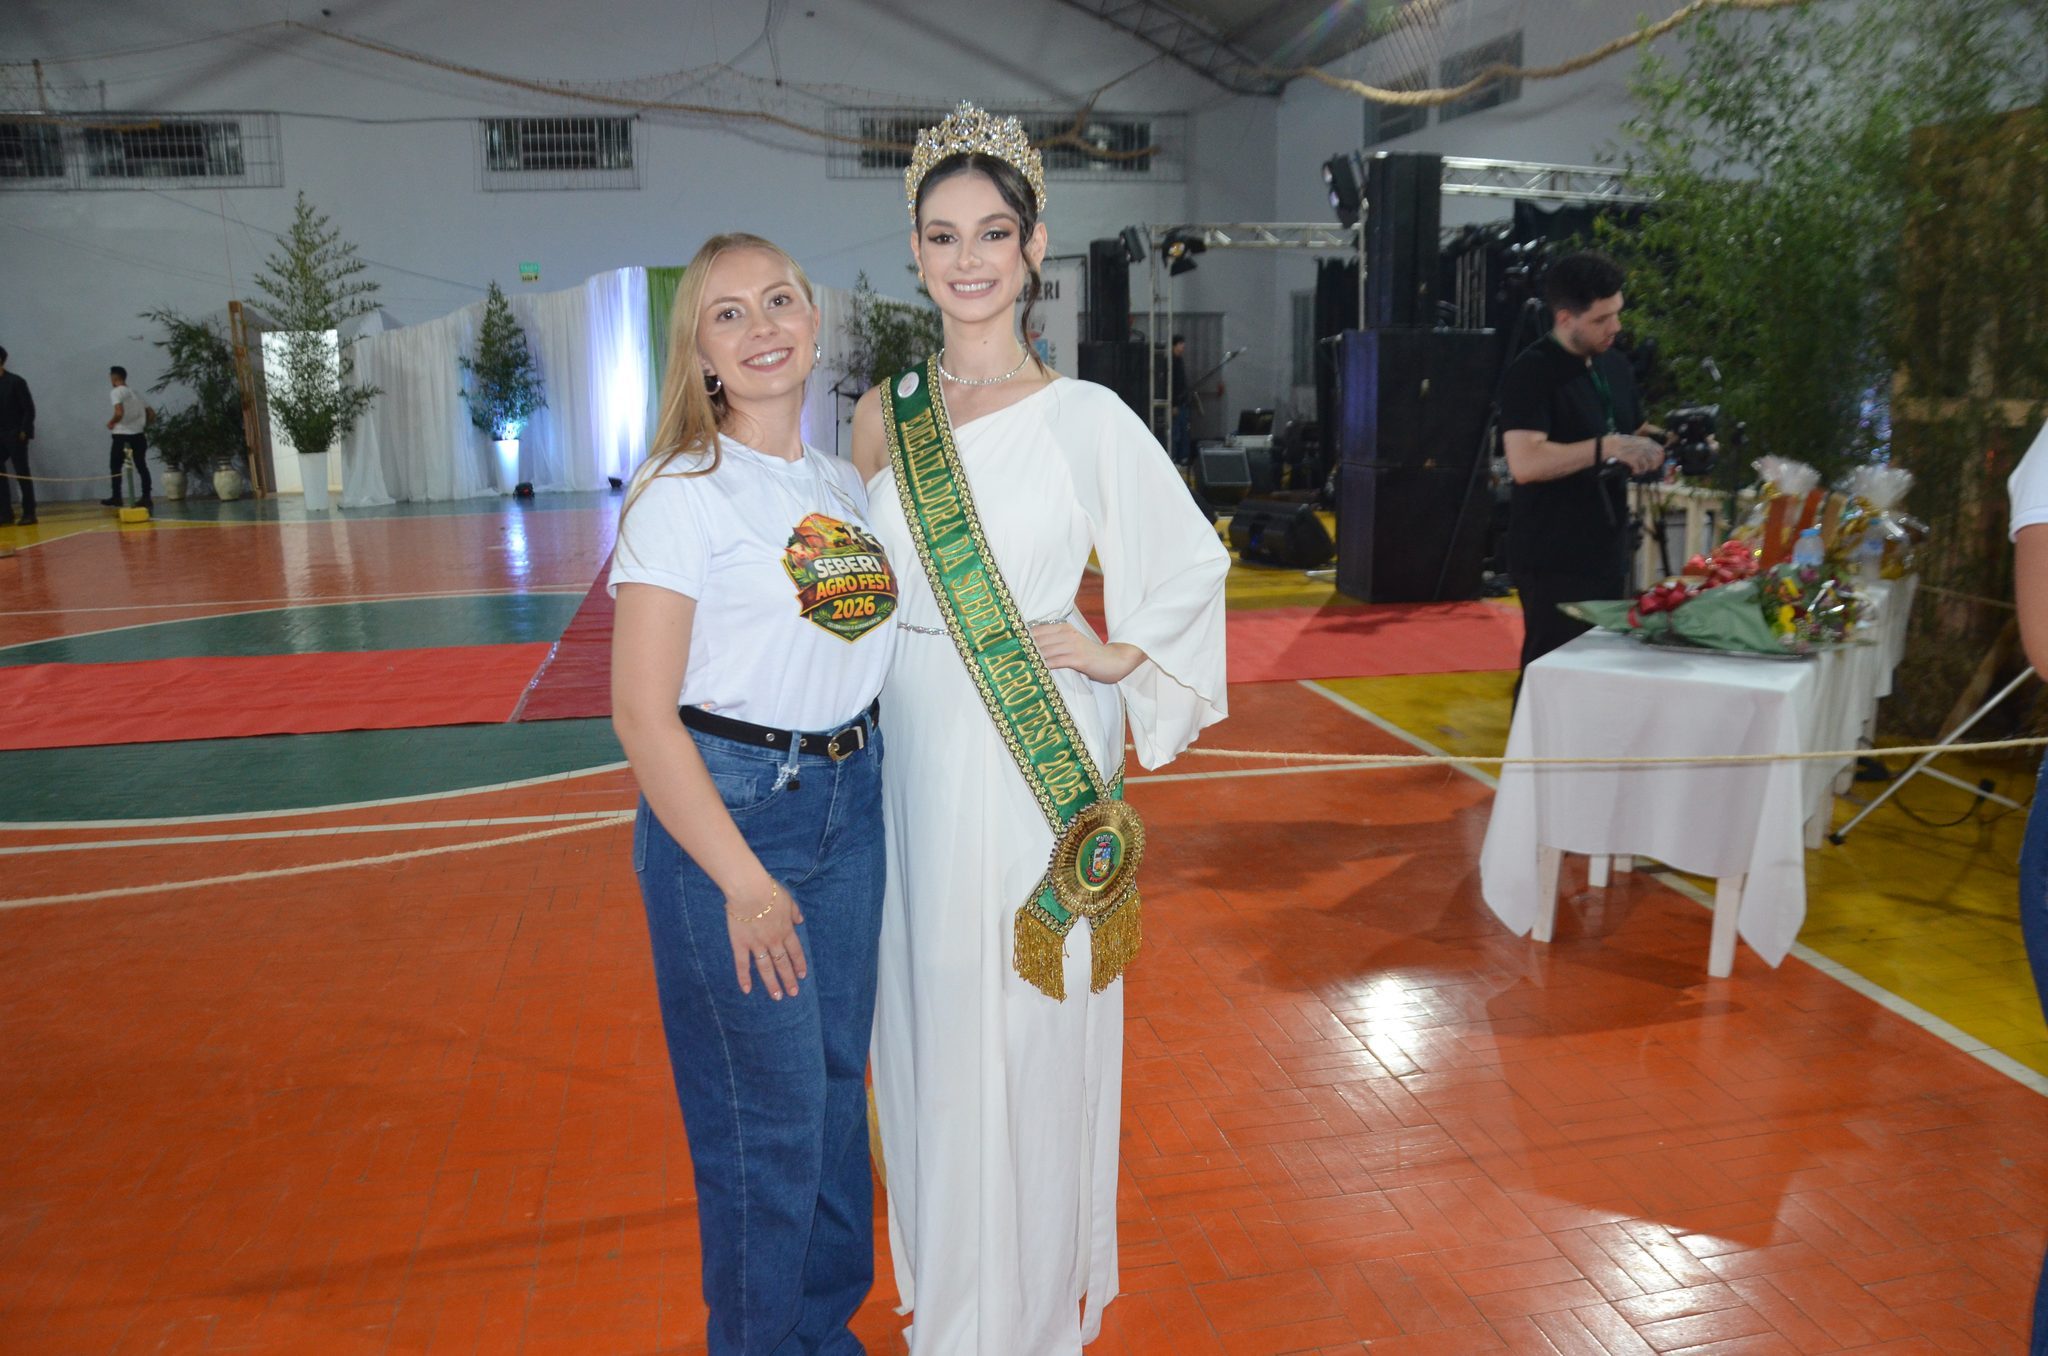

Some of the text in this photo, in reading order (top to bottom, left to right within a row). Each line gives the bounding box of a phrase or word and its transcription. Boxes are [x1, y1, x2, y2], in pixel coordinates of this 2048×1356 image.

[813, 555, 883, 579] SEBERI
[816, 573, 891, 600] AGRO FEST
[832, 595, 876, 619] 2026
[900, 406, 1090, 806] EMBAIXADORA DA SEBERI AGRO FEST 2025
